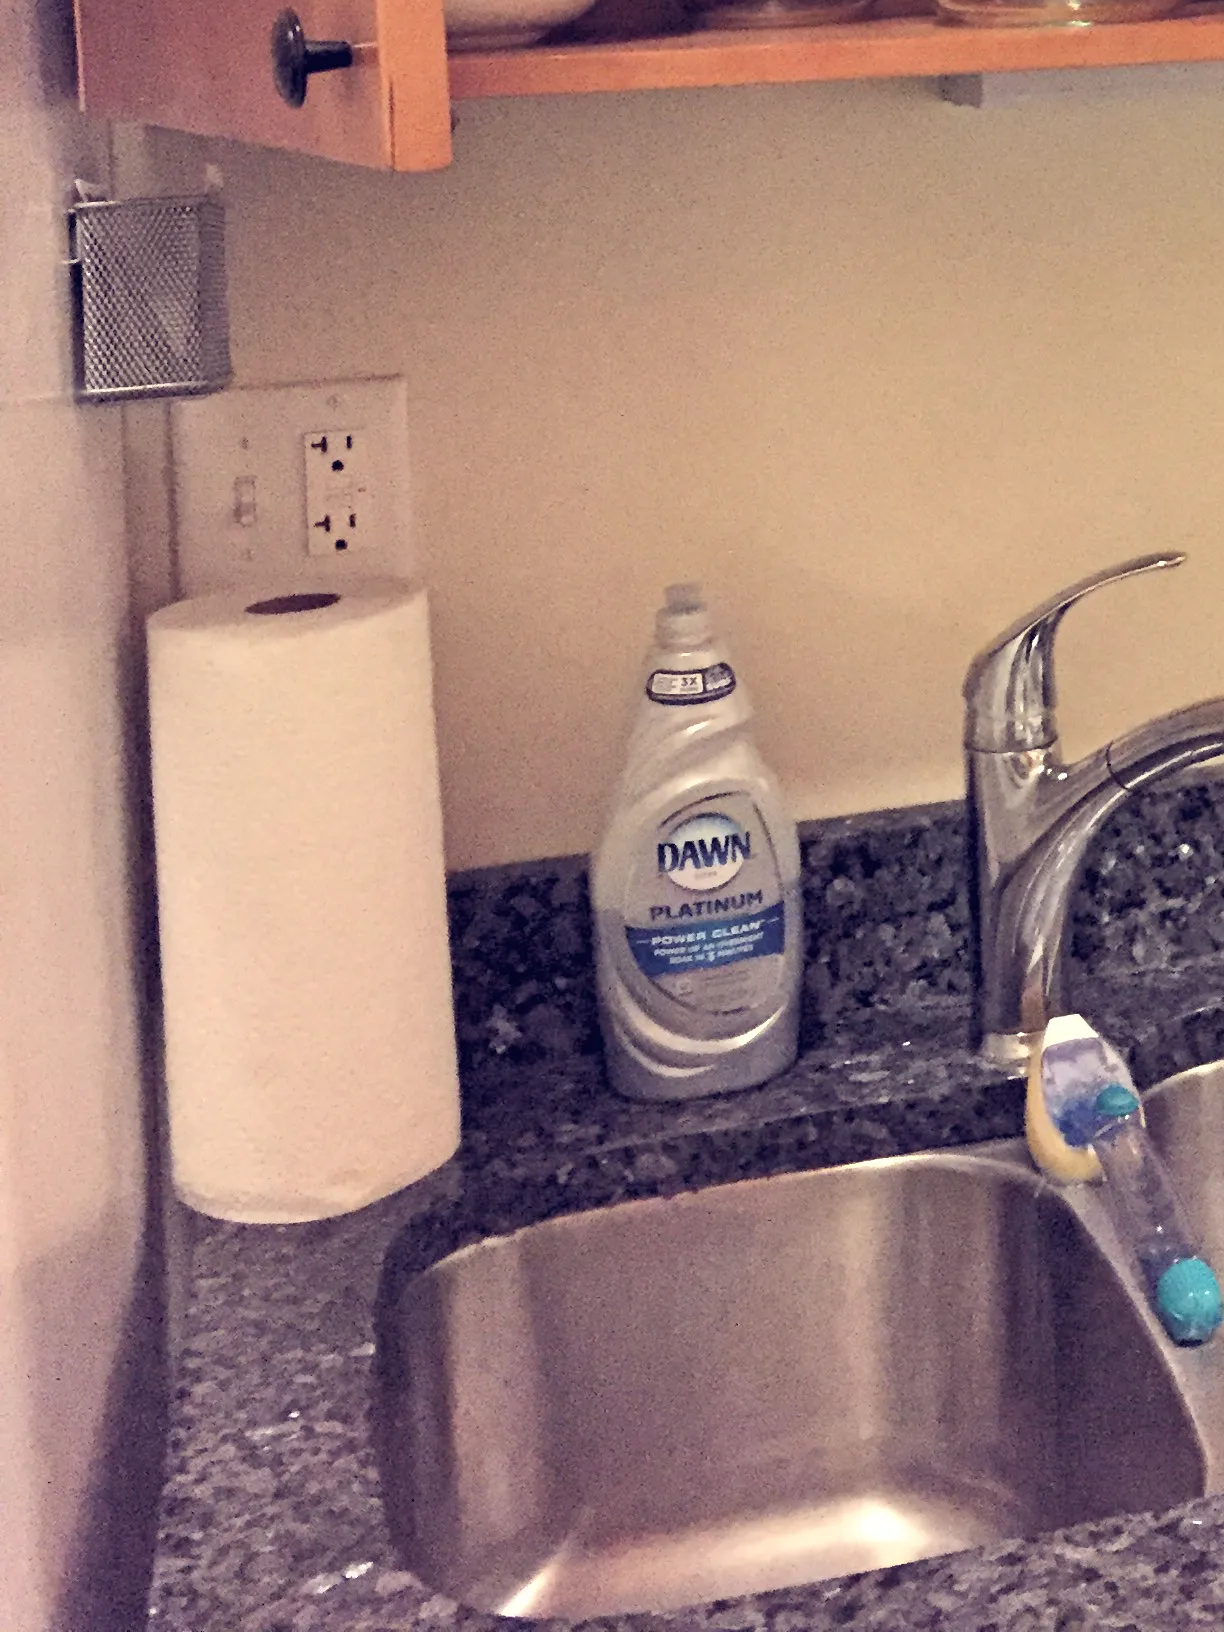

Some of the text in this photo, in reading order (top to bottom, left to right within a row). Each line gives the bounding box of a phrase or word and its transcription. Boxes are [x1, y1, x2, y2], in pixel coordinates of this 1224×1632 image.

[657, 831, 752, 873] DAWN
[650, 889, 764, 921] PLATINUM
[651, 921, 761, 946] POWER CLEAN
